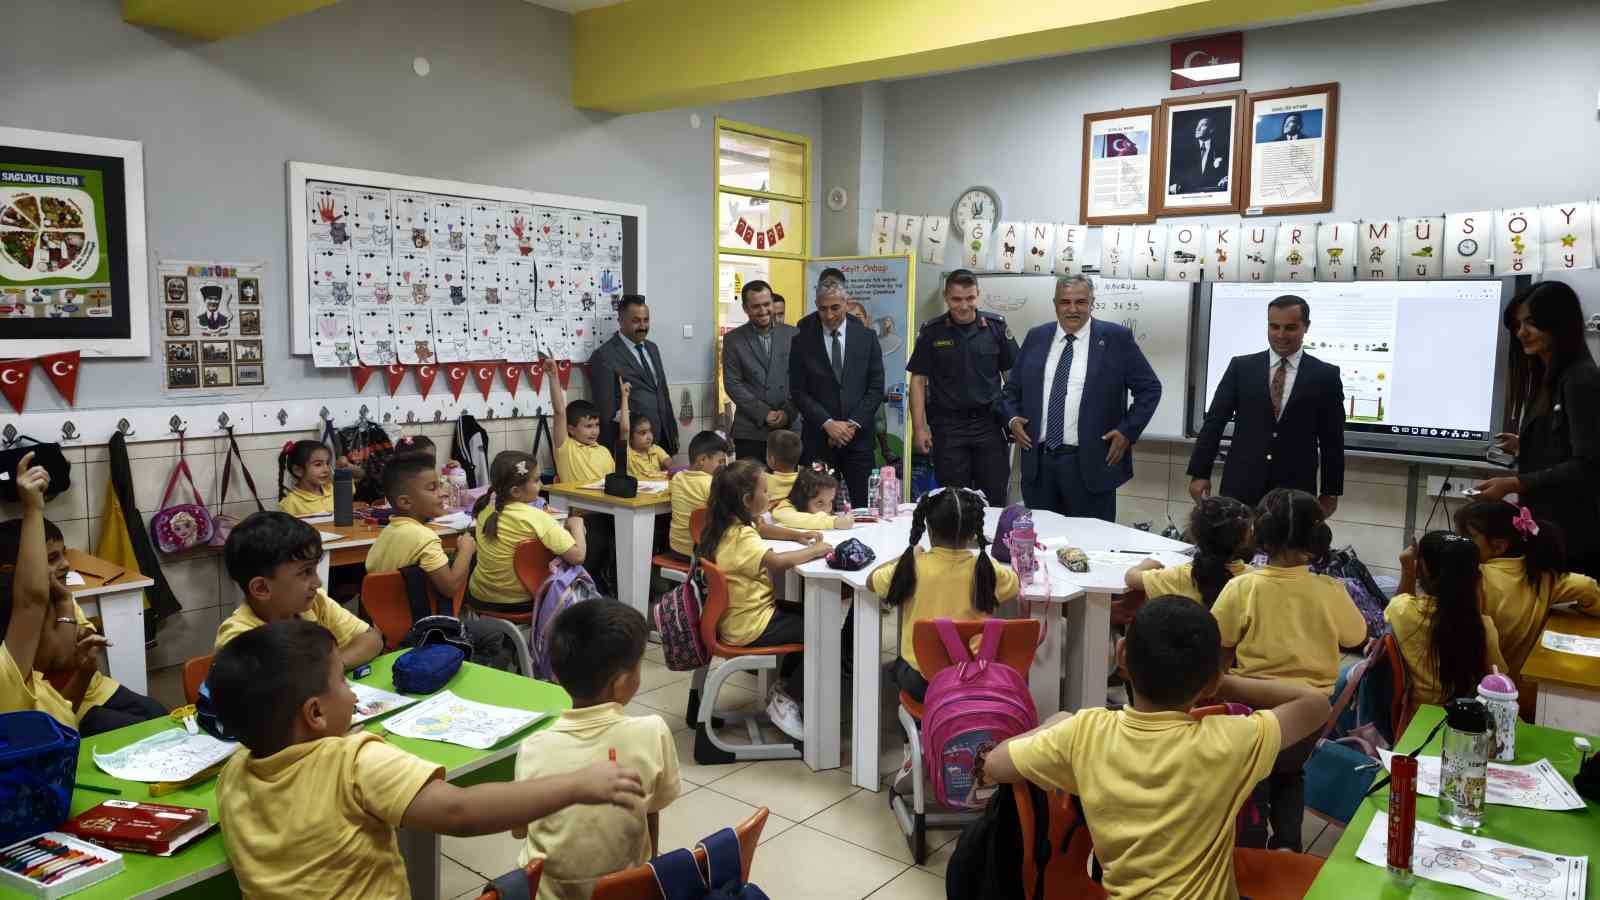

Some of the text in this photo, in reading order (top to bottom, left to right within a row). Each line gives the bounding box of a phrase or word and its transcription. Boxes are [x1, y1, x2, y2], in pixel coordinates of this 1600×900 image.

[881, 215, 889, 229] T
[906, 217, 915, 231] F
[931, 219, 939, 231] J
[972, 223, 983, 240] Ğ
[1006, 224, 1015, 240] A
[1034, 226, 1045, 240] N
[1067, 229, 1075, 243] E
[1147, 230, 1156, 244] L
[1178, 229, 1192, 244] O
[1218, 229, 1229, 244] K
[1252, 228, 1265, 243] U
[1291, 229, 1302, 244] R
[1369, 223, 1388, 240] M
[1416, 219, 1430, 240] Ü
[1463, 218, 1474, 234] S
[1508, 212, 1527, 234] Ö
[1560, 207, 1576, 225] Y
[1179, 271, 1187, 279] o
[1217, 264, 1224, 280] k
[1251, 271, 1261, 281] u
[1290, 271, 1299, 280] r
[1371, 269, 1384, 279] m
[1416, 264, 1427, 276] ü
[1463, 264, 1472, 274] s
[1512, 258, 1524, 272] ö
[1564, 253, 1575, 269] y
